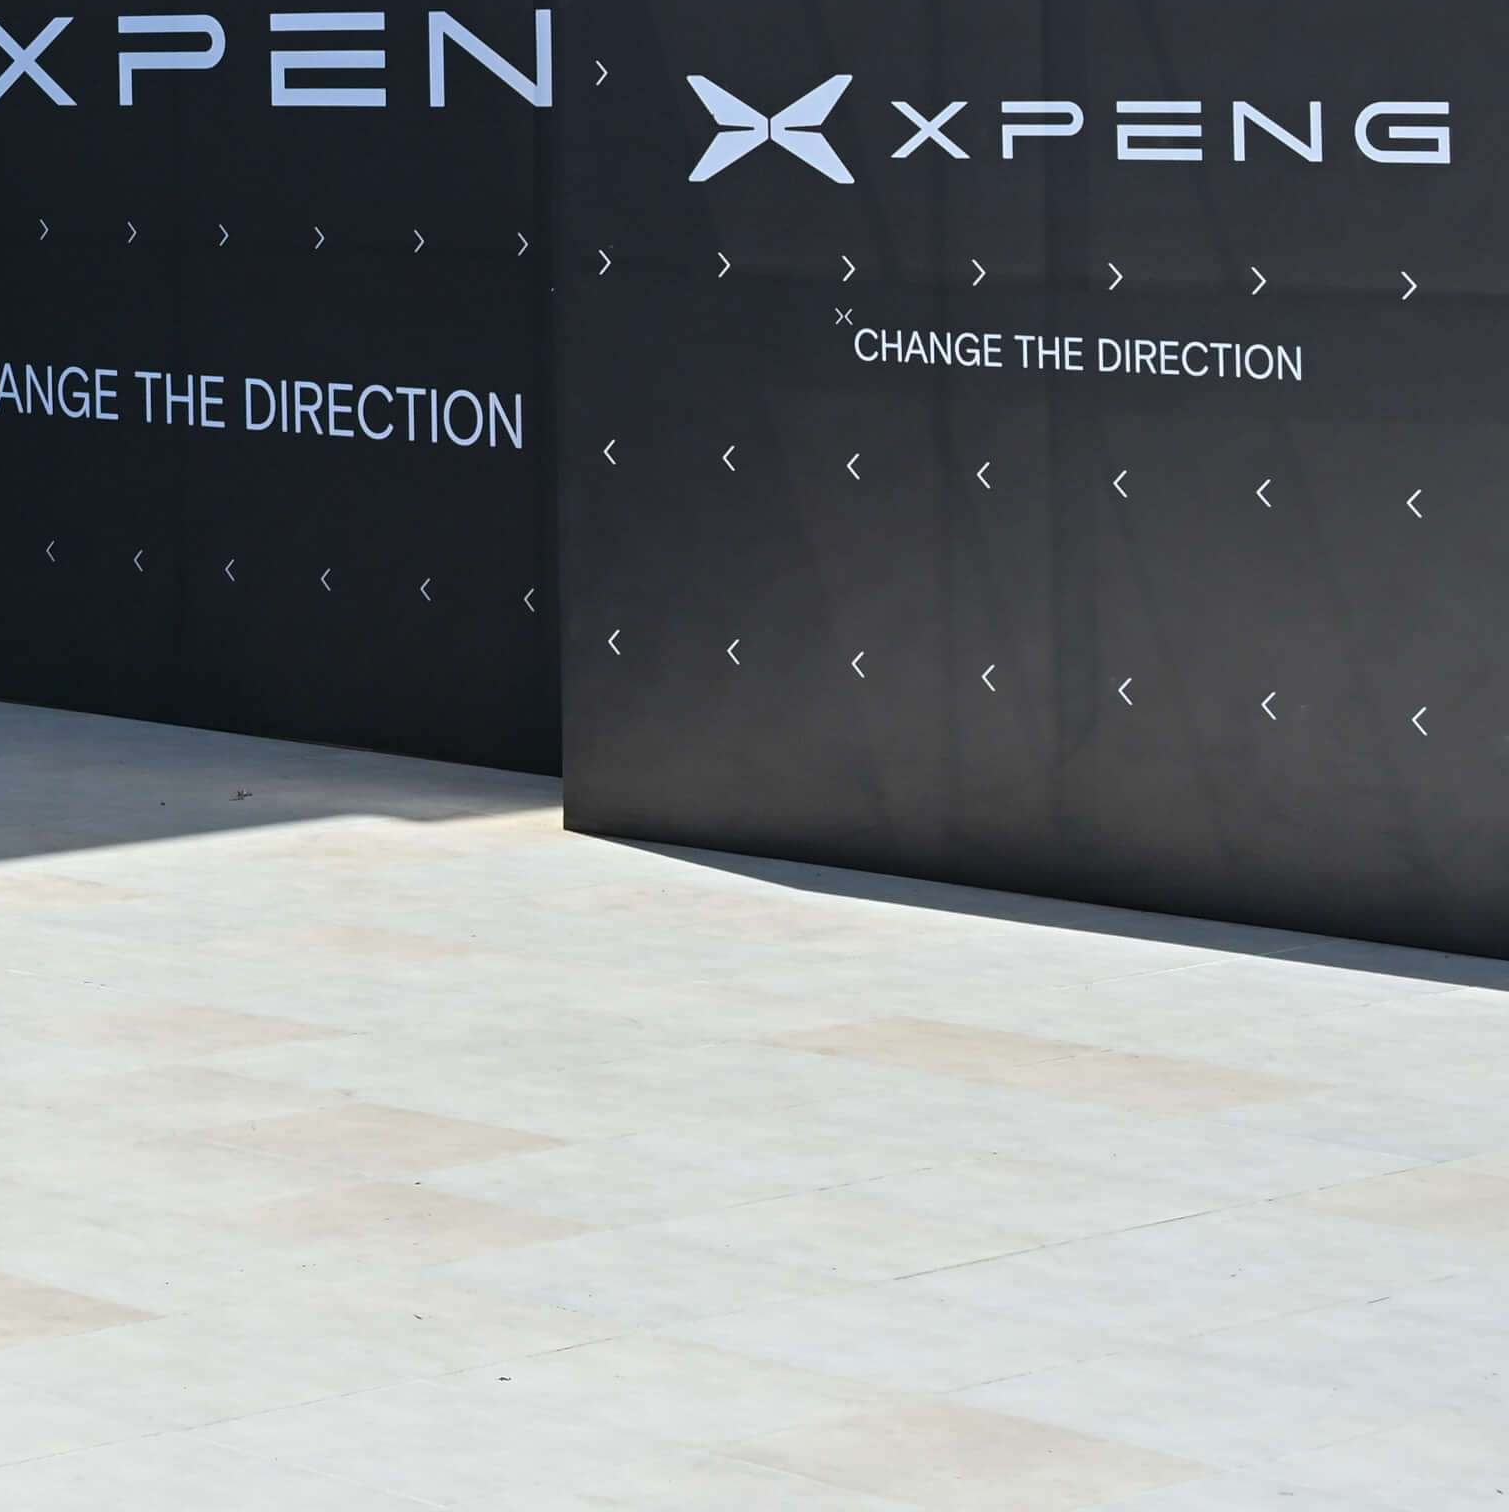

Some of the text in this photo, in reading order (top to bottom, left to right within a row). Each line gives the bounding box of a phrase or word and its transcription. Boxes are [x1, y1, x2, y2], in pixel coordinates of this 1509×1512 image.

[889, 100, 1451, 164] XPENG
[853, 328, 1303, 382] CHANGE THE DIRECTION
[134, 371, 226, 428] THE
[244, 378, 523, 449] DIRECTION
